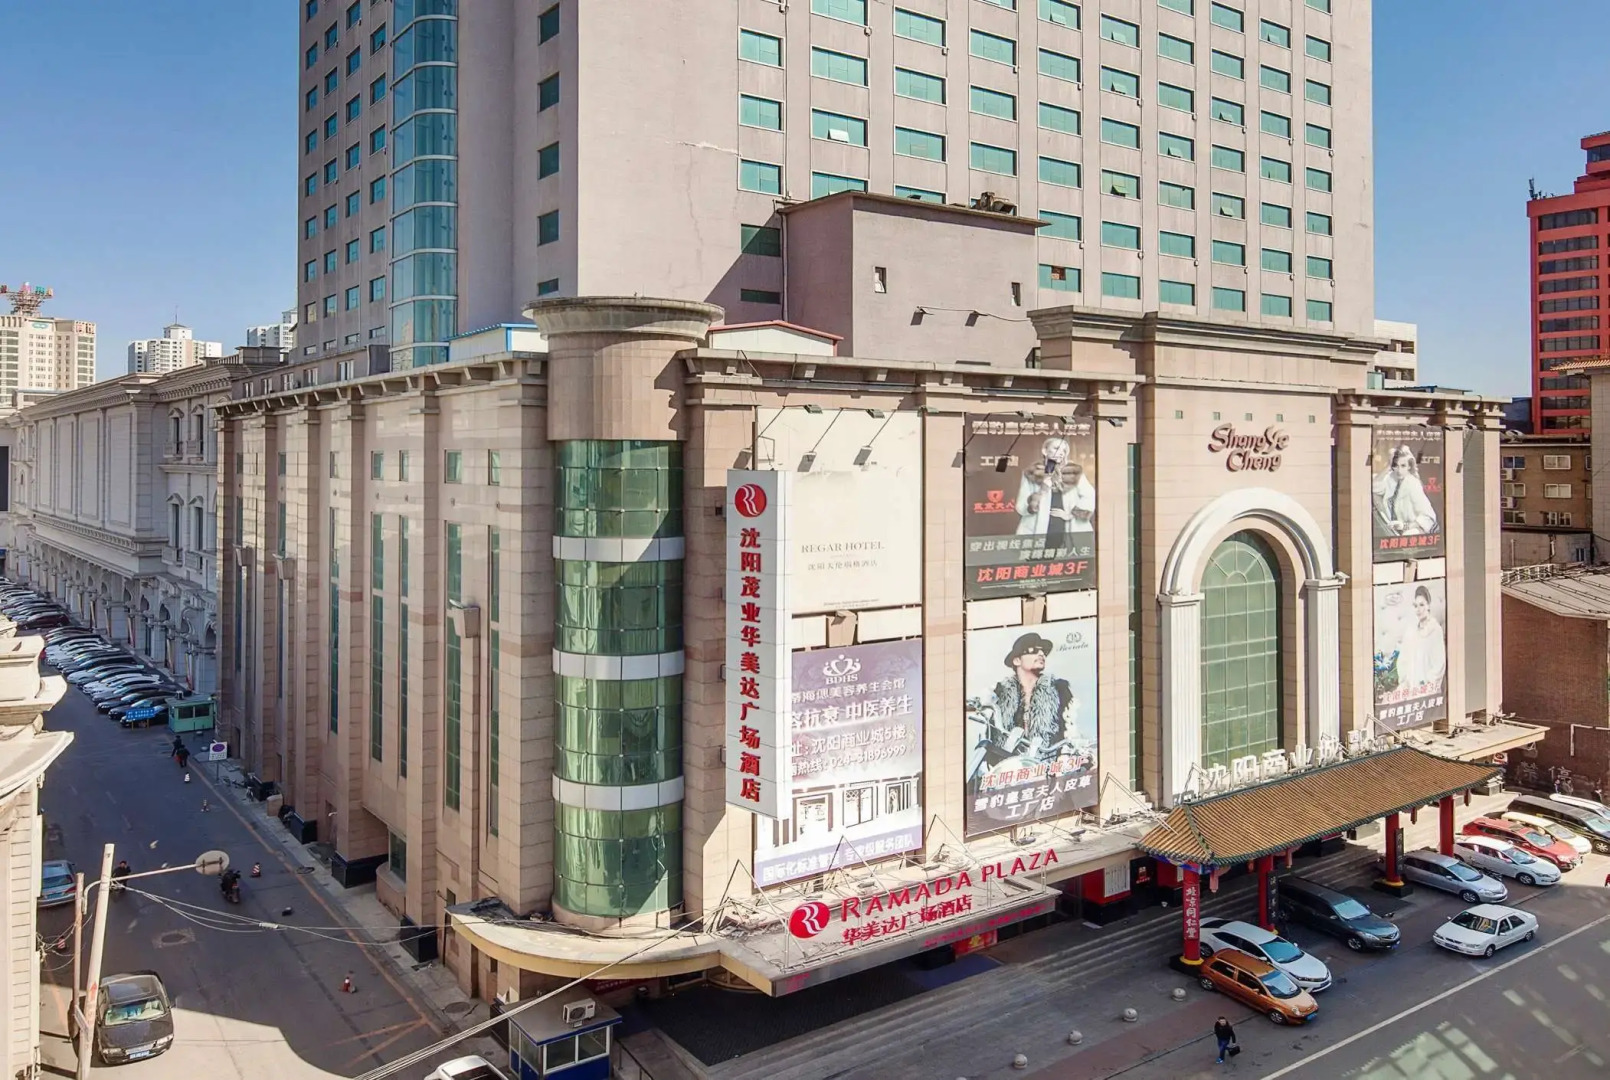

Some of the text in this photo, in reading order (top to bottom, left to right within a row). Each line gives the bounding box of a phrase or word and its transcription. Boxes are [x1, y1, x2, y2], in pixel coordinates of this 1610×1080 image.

[1226, 448, 1281, 472] Cheng
[801, 541, 885, 553] REGAR HOTEL
[977, 561, 1088, 582] 沈阳商业城3F
[739, 527, 762, 803] 沈阳茂业华美达广场酒店
[825, 673, 858, 685] BDHS
[845, 694, 914, 721] 中医养生
[1005, 795, 1056, 819] 工厂店
[841, 871, 972, 921] RAMADA
[981, 848, 1058, 882] PLAZA
[841, 894, 972, 946] 华美达广场酒店
